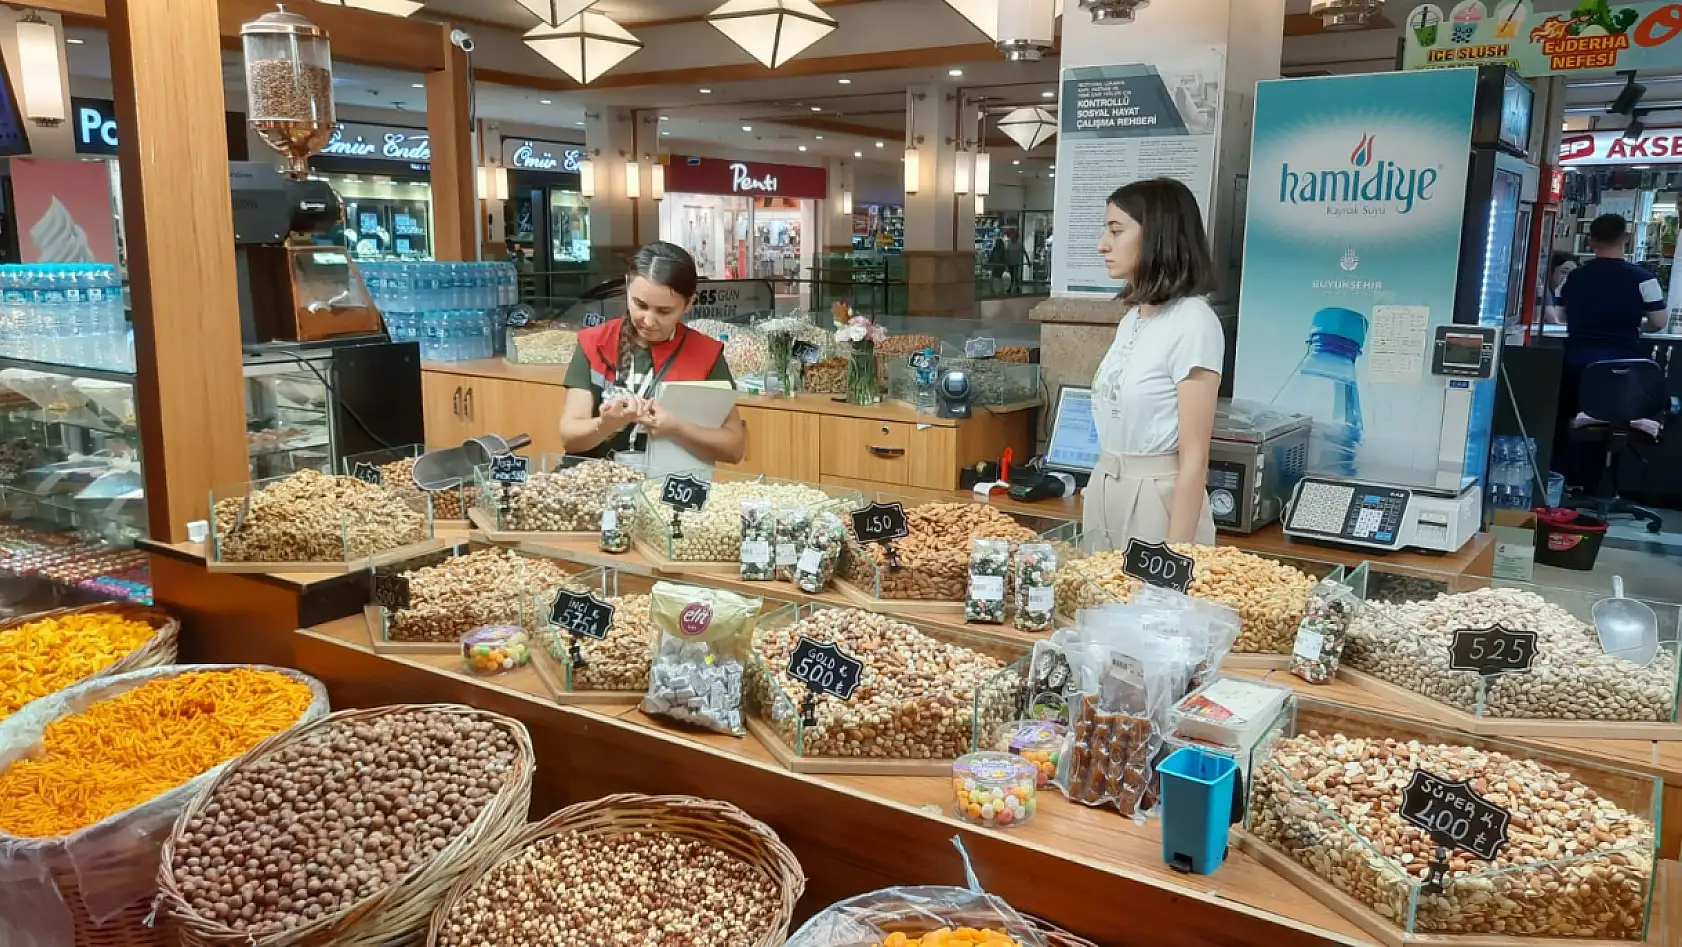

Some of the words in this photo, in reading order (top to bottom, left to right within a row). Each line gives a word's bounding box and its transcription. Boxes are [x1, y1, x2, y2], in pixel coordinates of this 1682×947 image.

[1427, 48, 1454, 62] ICE
[1458, 44, 1509, 59] SLUSH
[1544, 35, 1627, 54] EJDERHA
[1077, 95, 1130, 108] KONTROLLÜ
[1077, 109, 1109, 118] SOSYAL
[1112, 107, 1141, 116] HAYAT
[1077, 118, 1114, 129] ÇALIŞMA
[1117, 114, 1157, 127] REHBERİ
[513, 140, 557, 169] Ömür
[1279, 160, 1437, 214] hamidiye
[667, 481, 692, 502] 550
[865, 515, 892, 534] 450
[1138, 551, 1176, 579] 500
[808, 648, 835, 669] GOLD
[1469, 637, 1526, 663] 525
[796, 657, 834, 687] 500
[1420, 779, 1476, 820] SÜPER
[1414, 799, 1470, 839] 400
